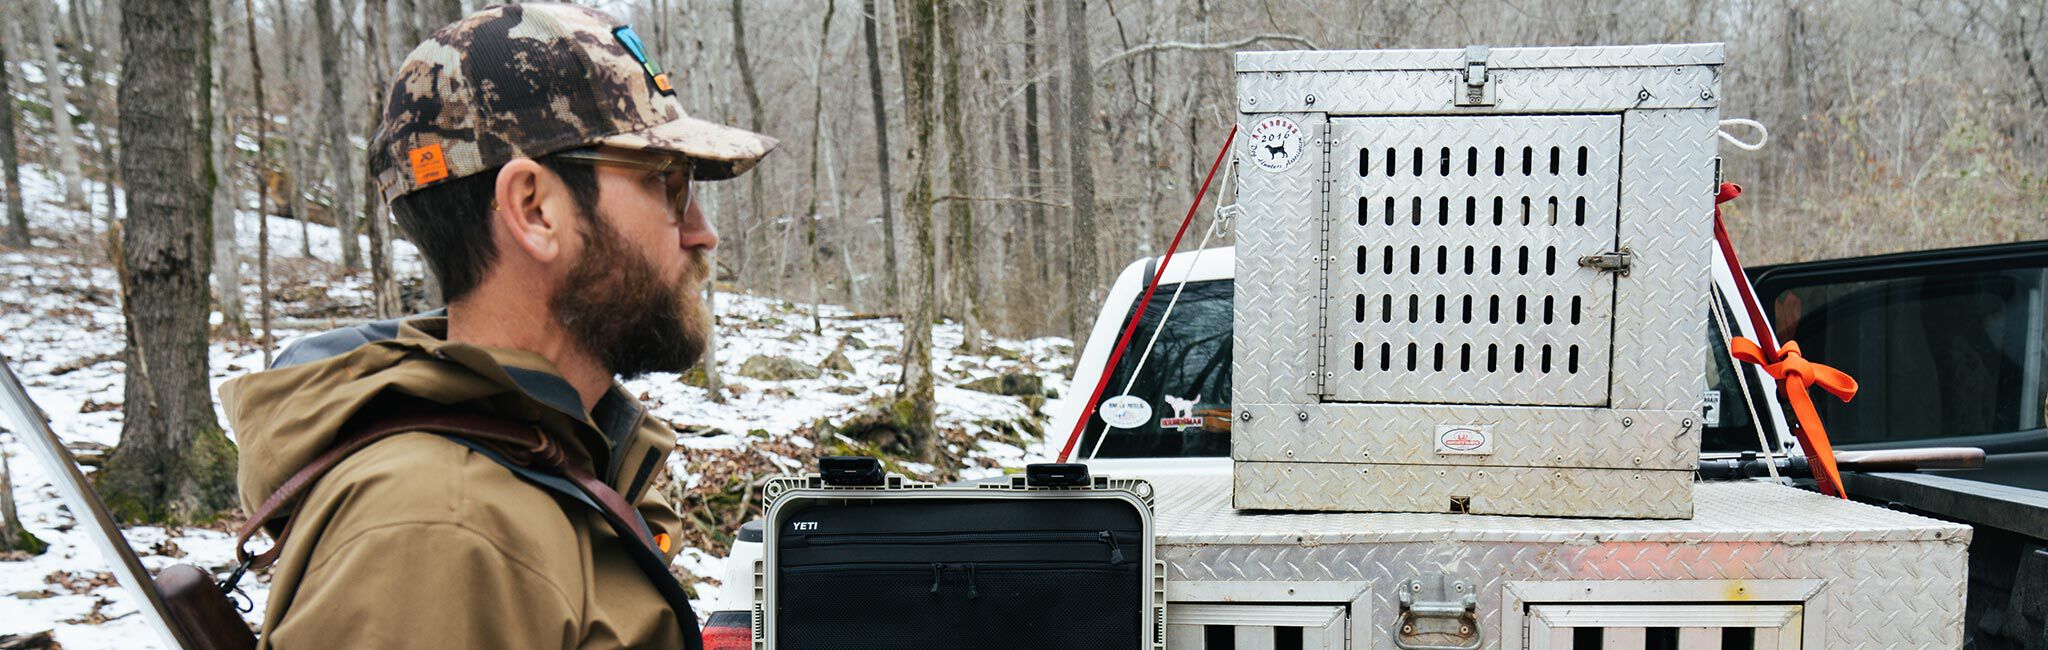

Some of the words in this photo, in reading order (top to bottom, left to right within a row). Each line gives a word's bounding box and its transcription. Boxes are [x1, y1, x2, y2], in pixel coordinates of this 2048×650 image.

[1252, 119, 1298, 140] Arkansas
[1261, 130, 1290, 143] 2016
[793, 521, 818, 530] YETI
